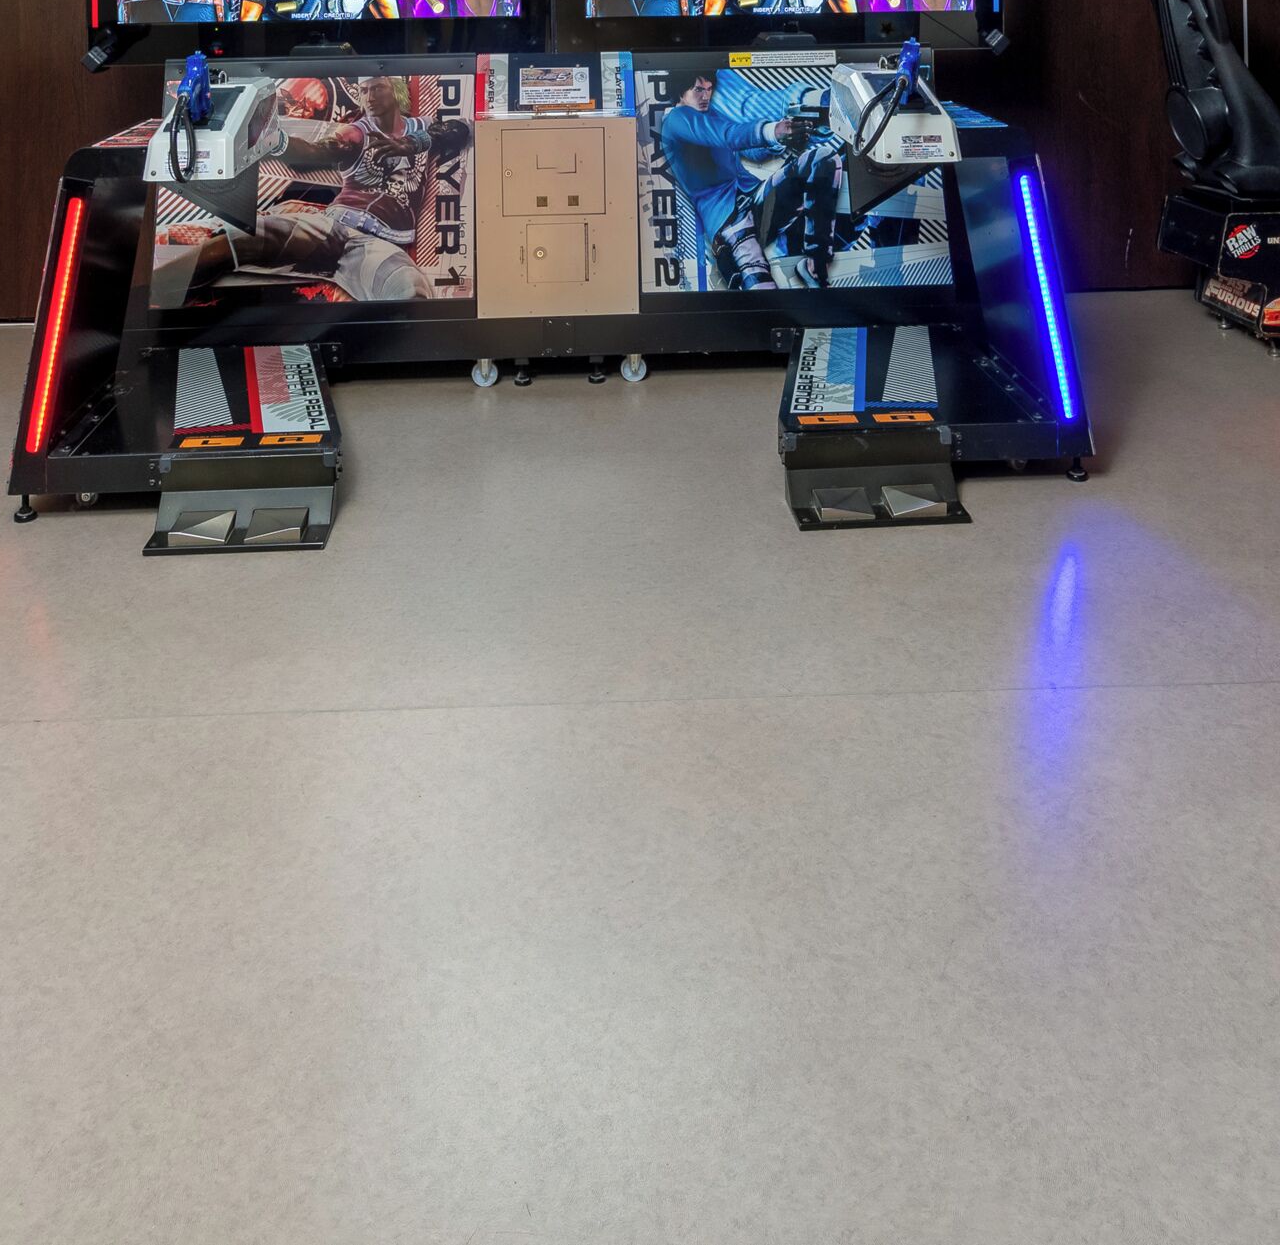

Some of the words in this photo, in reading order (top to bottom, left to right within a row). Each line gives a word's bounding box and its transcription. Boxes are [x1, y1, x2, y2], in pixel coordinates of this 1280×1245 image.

[487, 68, 495, 103] PLAYER
[614, 66, 622, 98] PLAYER
[459, 206, 468, 239] Luke
[1226, 224, 1257, 252] RAW
[1232, 235, 1262, 259] THRILLS
[434, 266, 461, 287] 1
[654, 257, 681, 288] 2
[1204, 279, 1261, 318] FURIOUS
[800, 346, 819, 372] PEDAL
[297, 362, 319, 397] DOUBLE
[793, 374, 814, 411] DOUBLE
[303, 397, 327, 430] PEDAL
